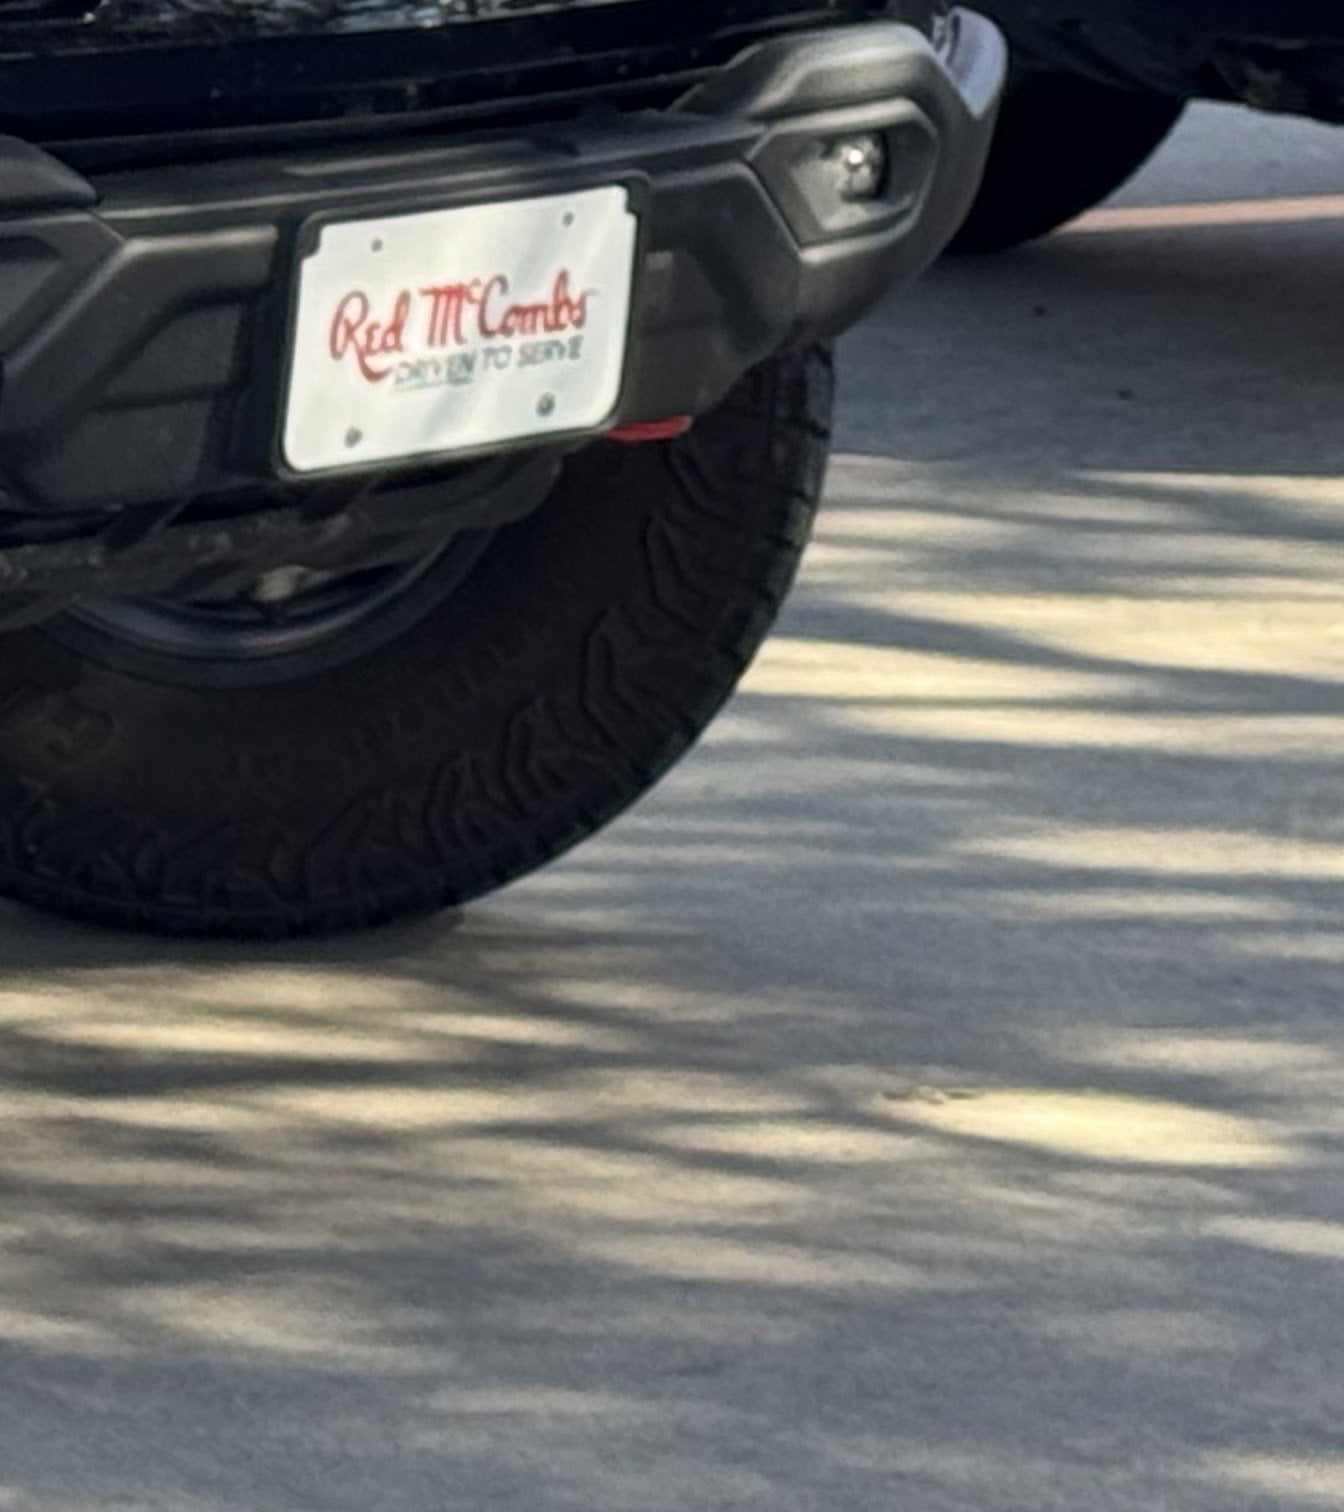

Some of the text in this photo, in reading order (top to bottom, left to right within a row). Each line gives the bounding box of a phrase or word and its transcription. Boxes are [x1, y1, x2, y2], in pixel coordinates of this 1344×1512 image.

[330, 269, 596, 382] Red McCombs
[482, 348, 511, 369] TO
